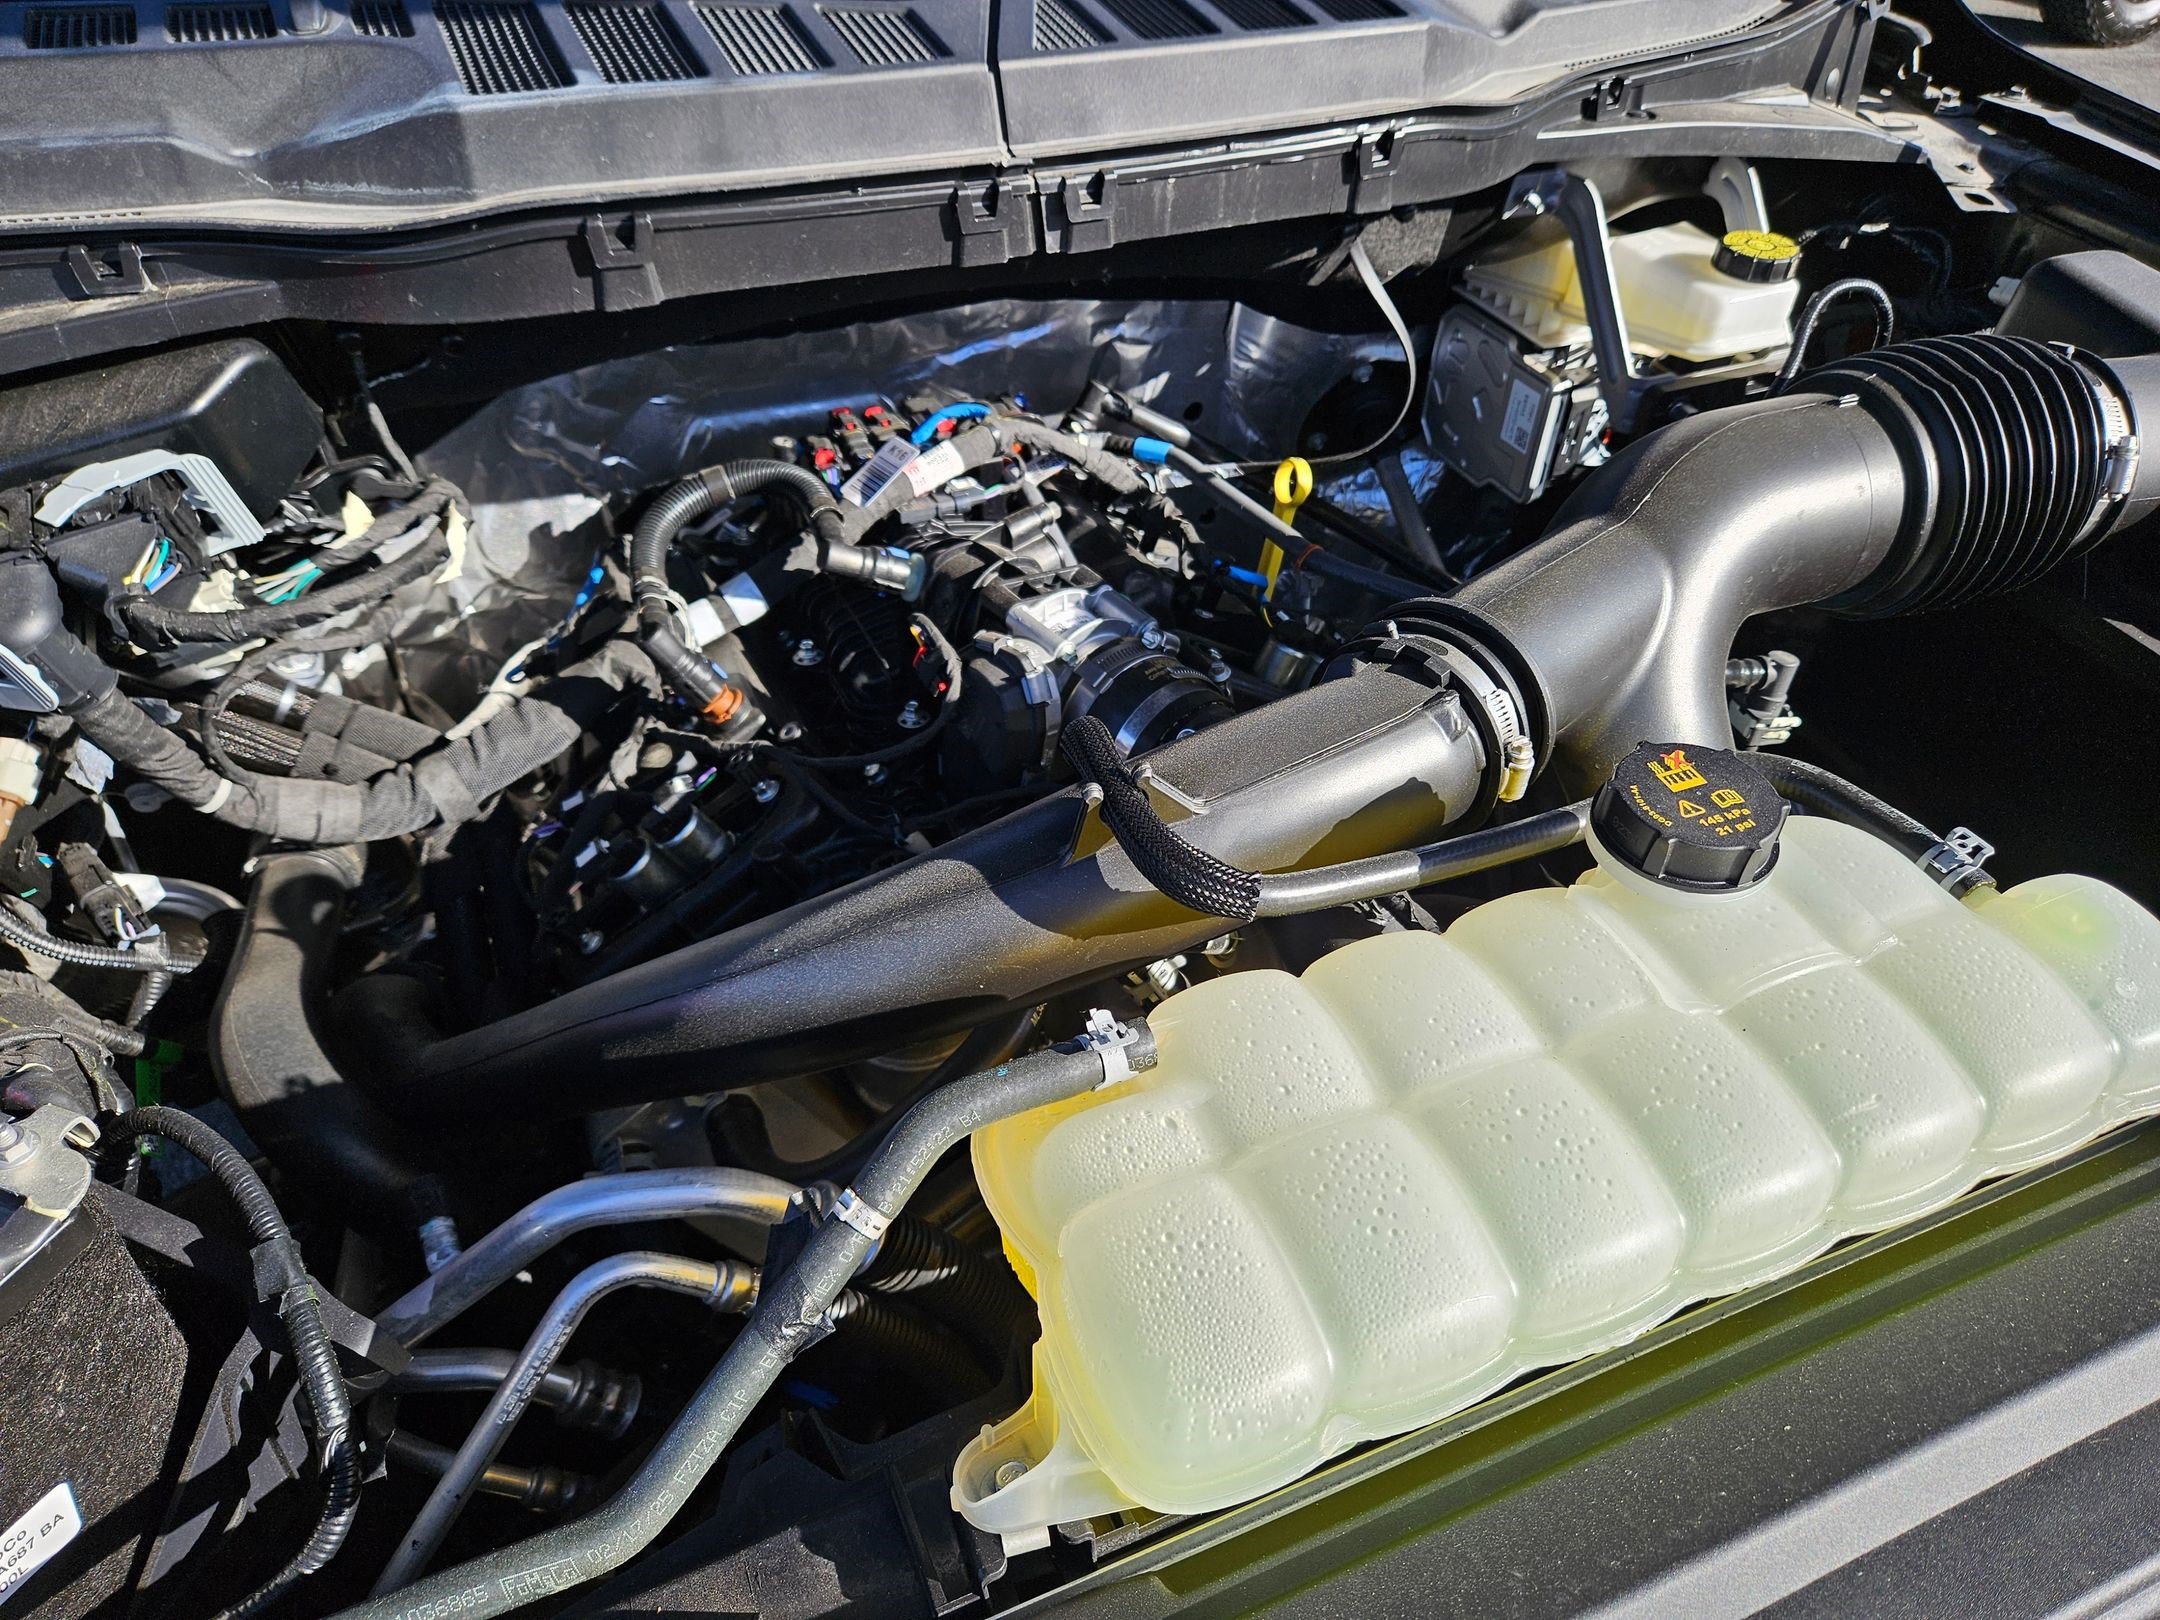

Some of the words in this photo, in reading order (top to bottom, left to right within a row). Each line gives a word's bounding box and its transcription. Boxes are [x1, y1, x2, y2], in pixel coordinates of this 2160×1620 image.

[1699, 814, 1724, 827] 145
[1724, 808, 1751, 820] kPa
[1715, 825, 1733, 837] 21
[1735, 819, 1756, 832] psi
[587, 1489, 674, 1563] 02/17/25
[673, 1430, 722, 1484] FZTZA
[40, 1513, 65, 1537] BA
